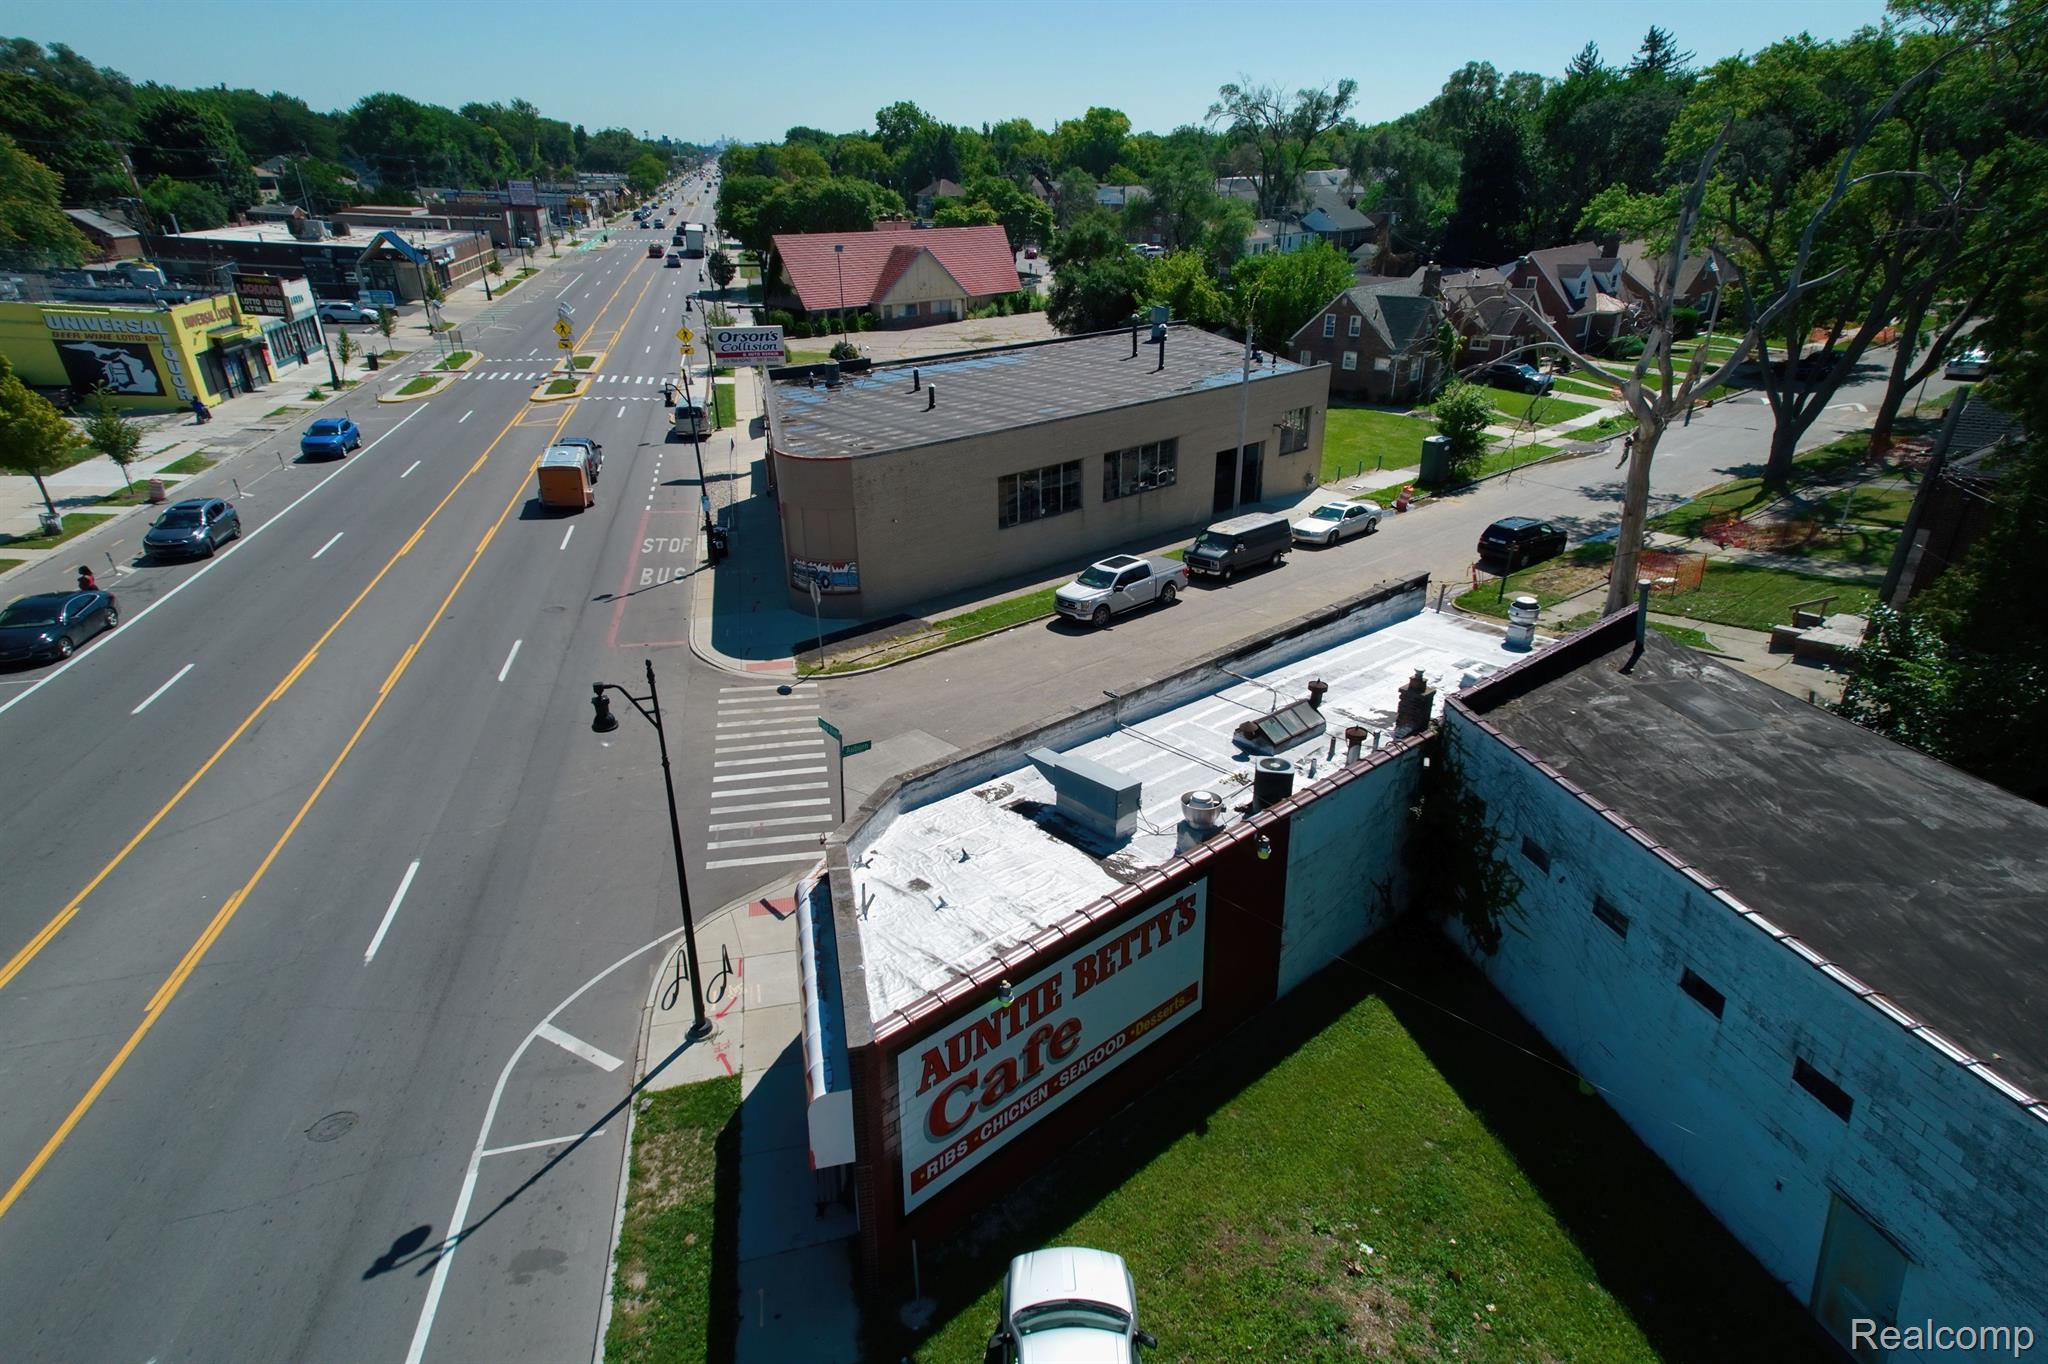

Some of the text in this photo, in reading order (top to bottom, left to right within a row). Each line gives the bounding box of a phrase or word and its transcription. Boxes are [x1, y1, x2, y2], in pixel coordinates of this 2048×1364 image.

[241, 297, 261, 306] LOTTO
[264, 298, 284, 307] BEER
[244, 305, 285, 314] ATM WINE
[43, 314, 168, 334] UNIVERSAL
[52, 331, 80, 339] BEER
[84, 332, 112, 341] WINE
[717, 330, 779, 343] Orson's
[721, 341, 778, 352] Collision
[639, 566, 687, 586] BUS
[916, 893, 1197, 1097] AUNTIE BETTY'S
[925, 1017, 1083, 1142] Cafe
[926, 1140, 968, 1179] RIBS
[980, 1084, 1049, 1141] CHICKEN
[1059, 1033, 1127, 1088] SEAFOOD
